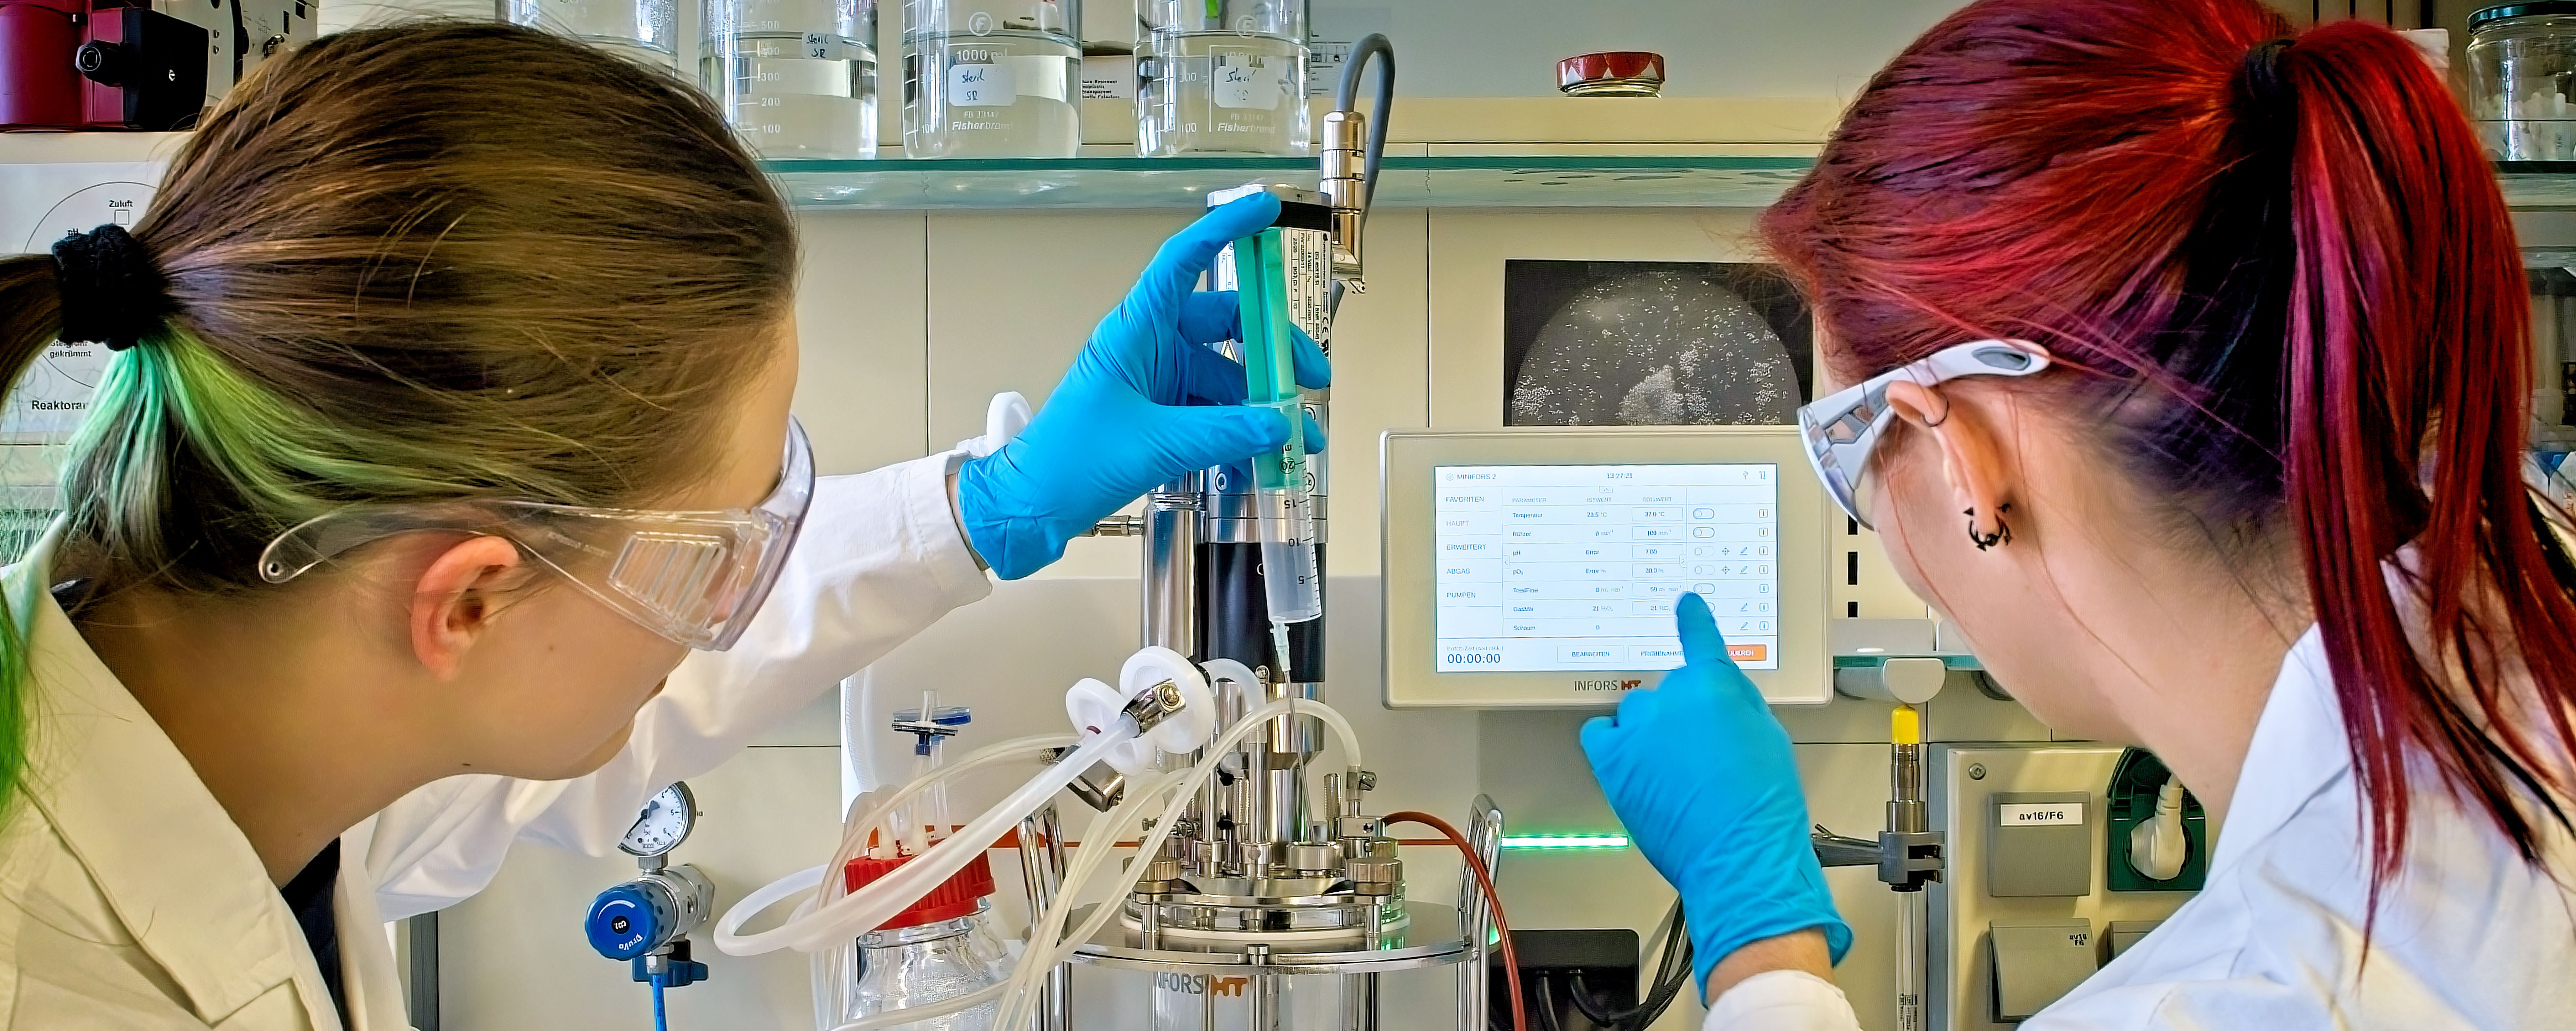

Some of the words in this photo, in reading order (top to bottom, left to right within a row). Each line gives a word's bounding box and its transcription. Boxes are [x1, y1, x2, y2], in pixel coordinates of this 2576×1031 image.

[956, 50, 987, 61] 1000
[761, 73, 780, 81] 300
[762, 98, 780, 107] 200
[762, 125, 780, 133] 100
[1181, 123, 1197, 133] 100
[1281, 460, 1295, 471] 20
[1284, 499, 1297, 509] 15
[1289, 537, 1299, 546] 10
[1298, 576, 1304, 585] 5
[1448, 654, 1501, 663] 00:00:00
[1574, 680, 1618, 691] INFORS
[2019, 811, 2064, 820] av16/F6
